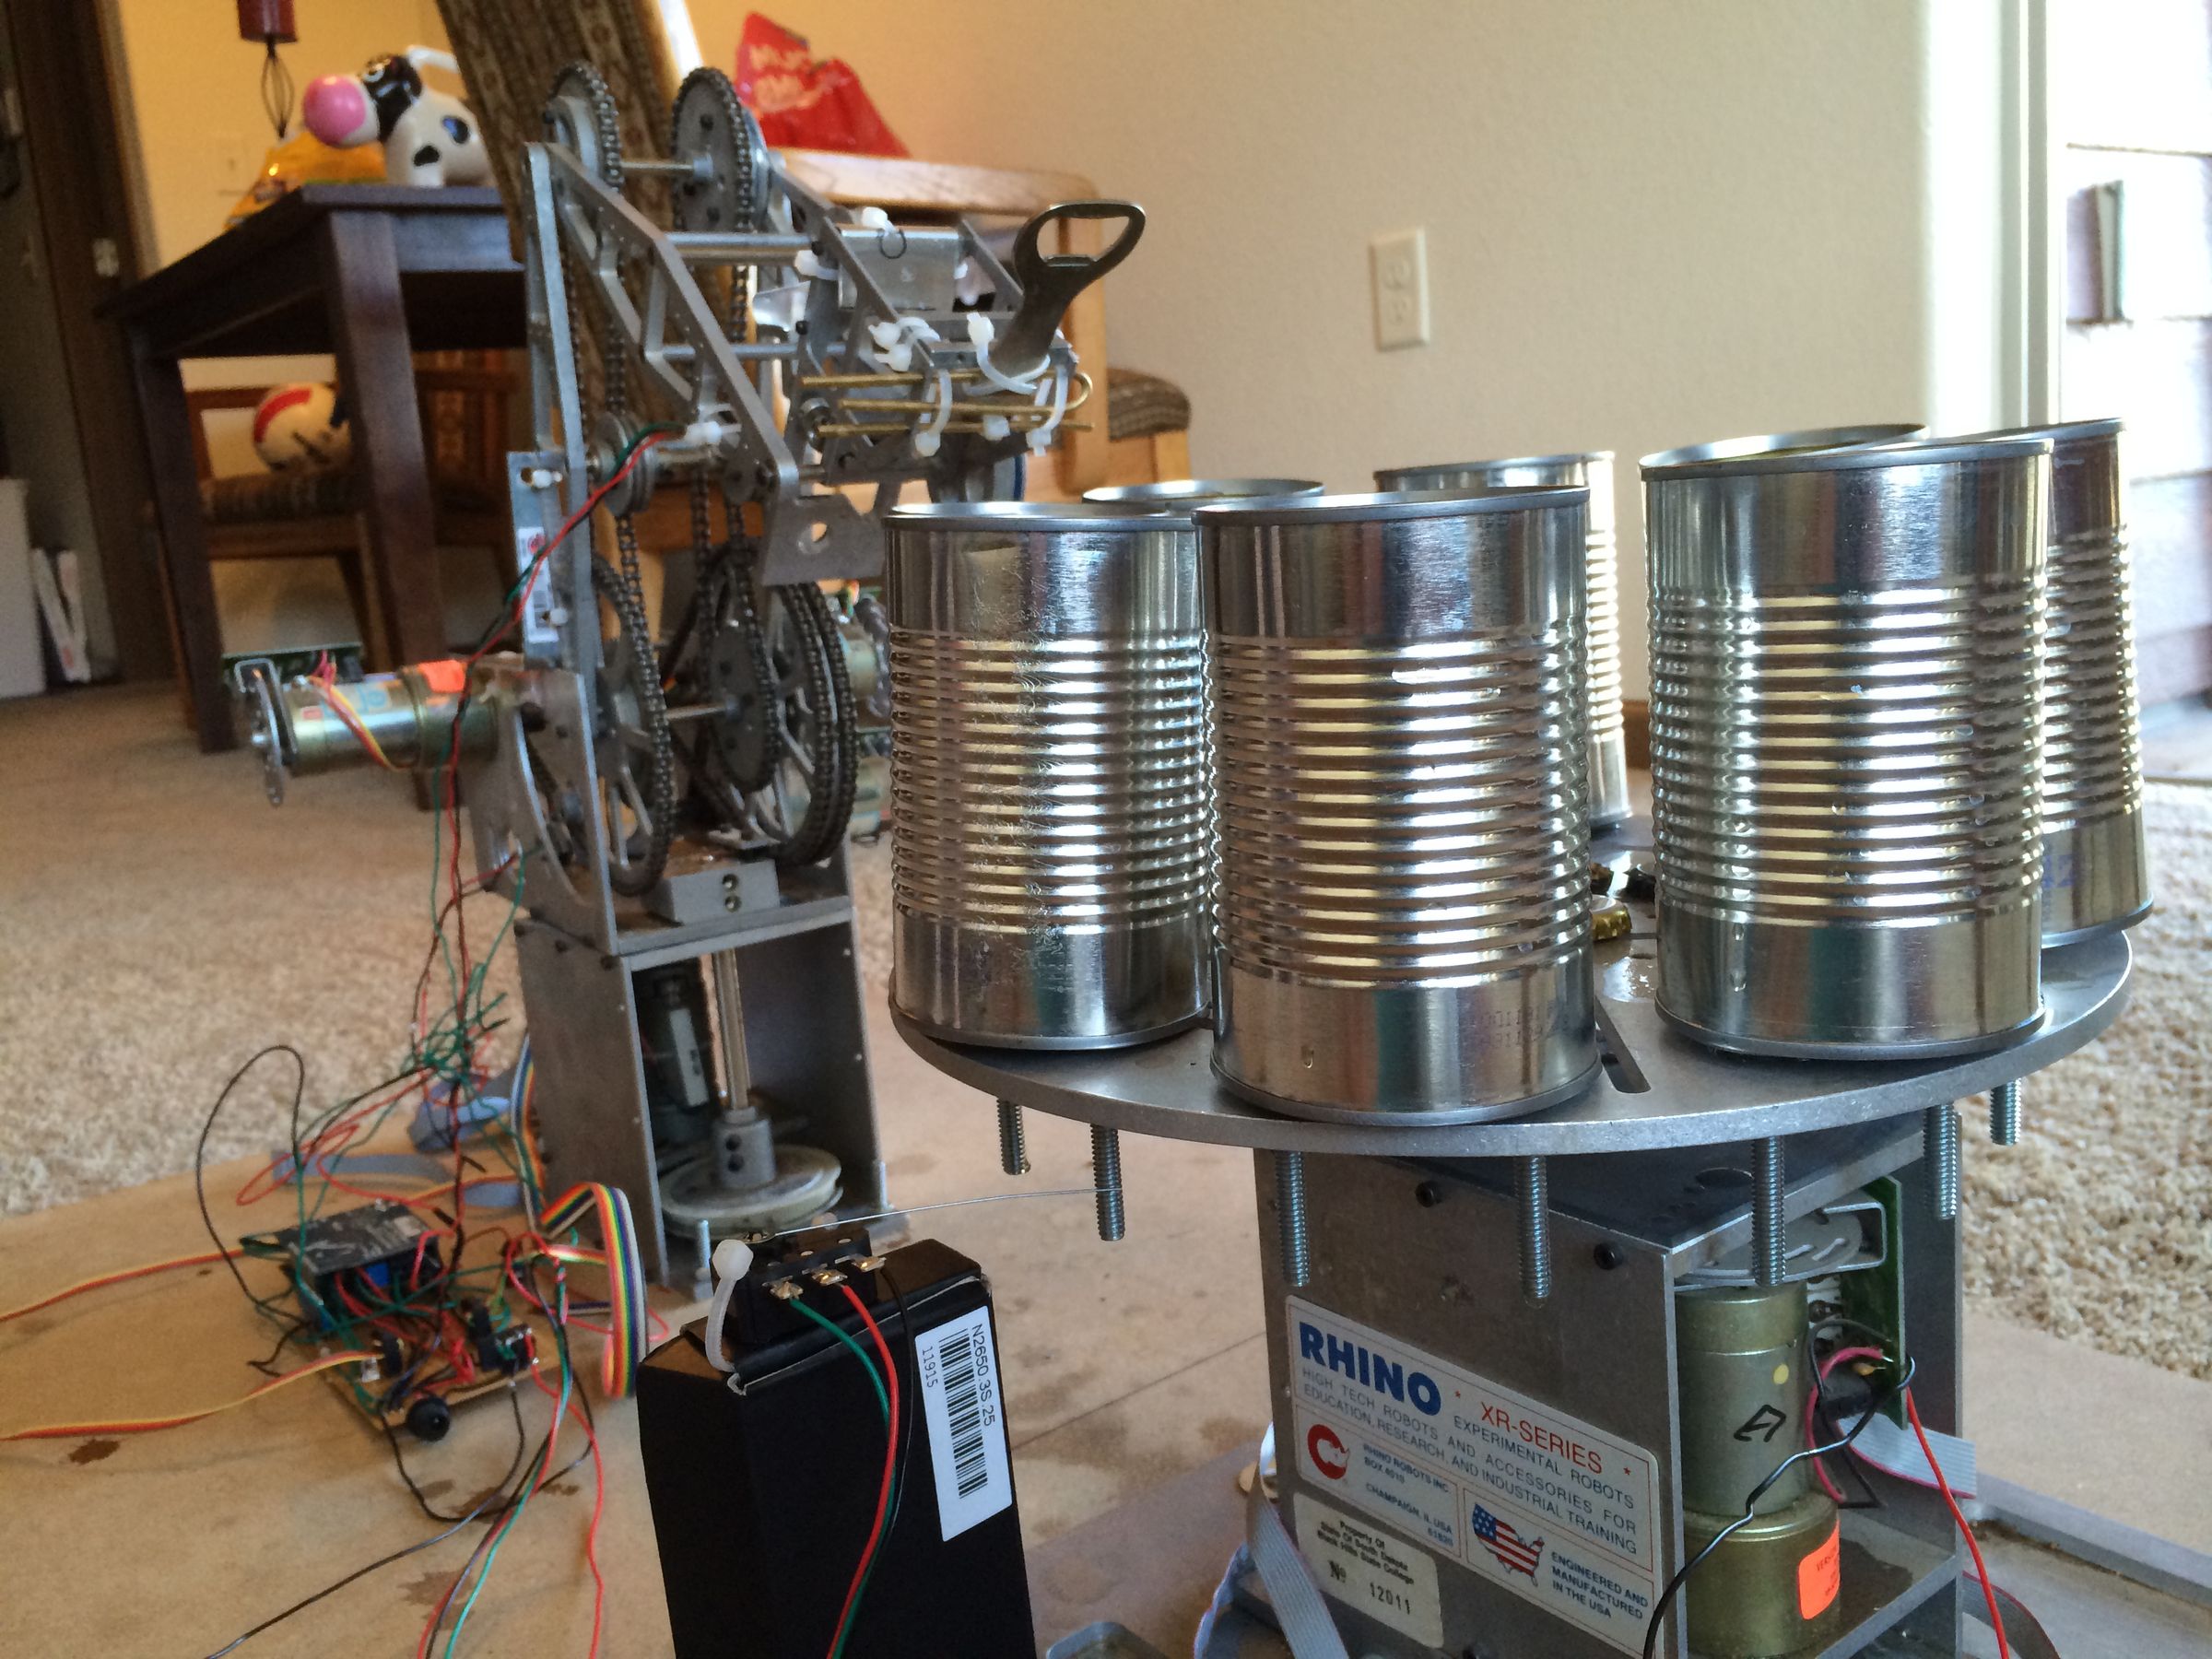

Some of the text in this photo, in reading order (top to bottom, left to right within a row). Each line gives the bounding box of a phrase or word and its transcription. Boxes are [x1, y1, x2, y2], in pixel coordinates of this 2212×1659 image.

[922, 1346, 938, 1388] 11915
[1300, 1322, 1441, 1416] RHINO
[1302, 1368, 1636, 1535] HIGH TECH ROBOTS AND ACCESSORIES FOR
[1363, 1443, 1392, 1465] RHINO
[1394, 1457, 1431, 1484] ROBOTS
[1453, 1416, 1634, 1510] EXPERIMENTAL ROBOTS
[1481, 1401, 1602, 1475] XR-SERIES
[1433, 1517, 1453, 1535] USA
[1452, 1455, 1478, 1477] AND
[1482, 1468, 1563, 1519] INDUSTRIAL
[1568, 1511, 1637, 1555] TRAINING
[1370, 1582, 1410, 1615] 12011
[1551, 1551, 1649, 1607] ENGINEERED AND
[1551, 1566, 1643, 1619] MANUFACTURED
[1552, 1580, 1612, 1618] IN THE USA
